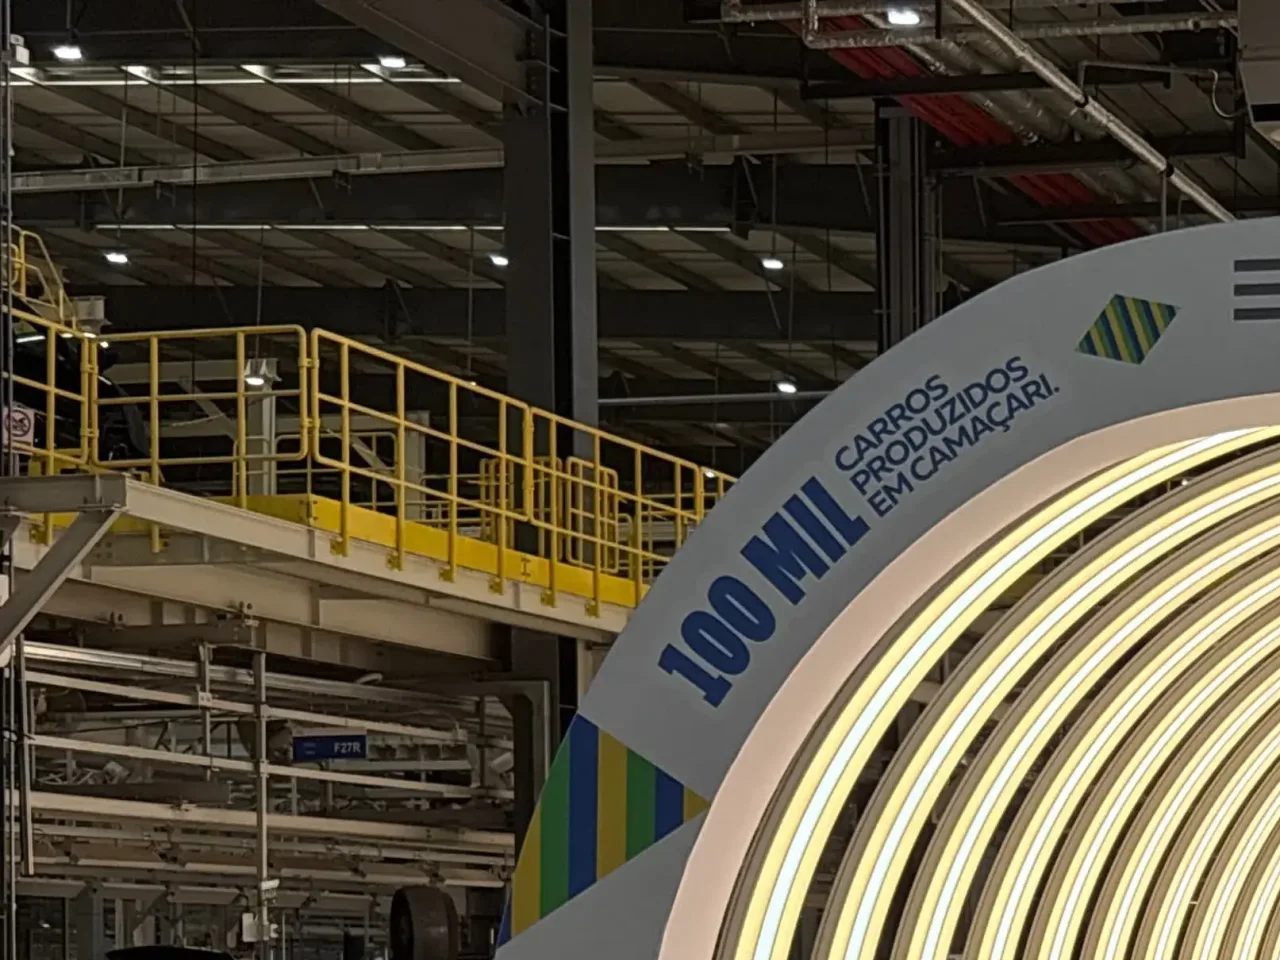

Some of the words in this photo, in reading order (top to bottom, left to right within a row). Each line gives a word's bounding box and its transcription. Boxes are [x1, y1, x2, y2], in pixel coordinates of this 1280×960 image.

[835, 374, 949, 471] CARROS
[850, 356, 1029, 496] PRODUZIDOS
[867, 472, 914, 518] EM
[910, 373, 1060, 481] CAMAÇARI.
[657, 575, 776, 708] 100
[740, 475, 871, 606] MIL
